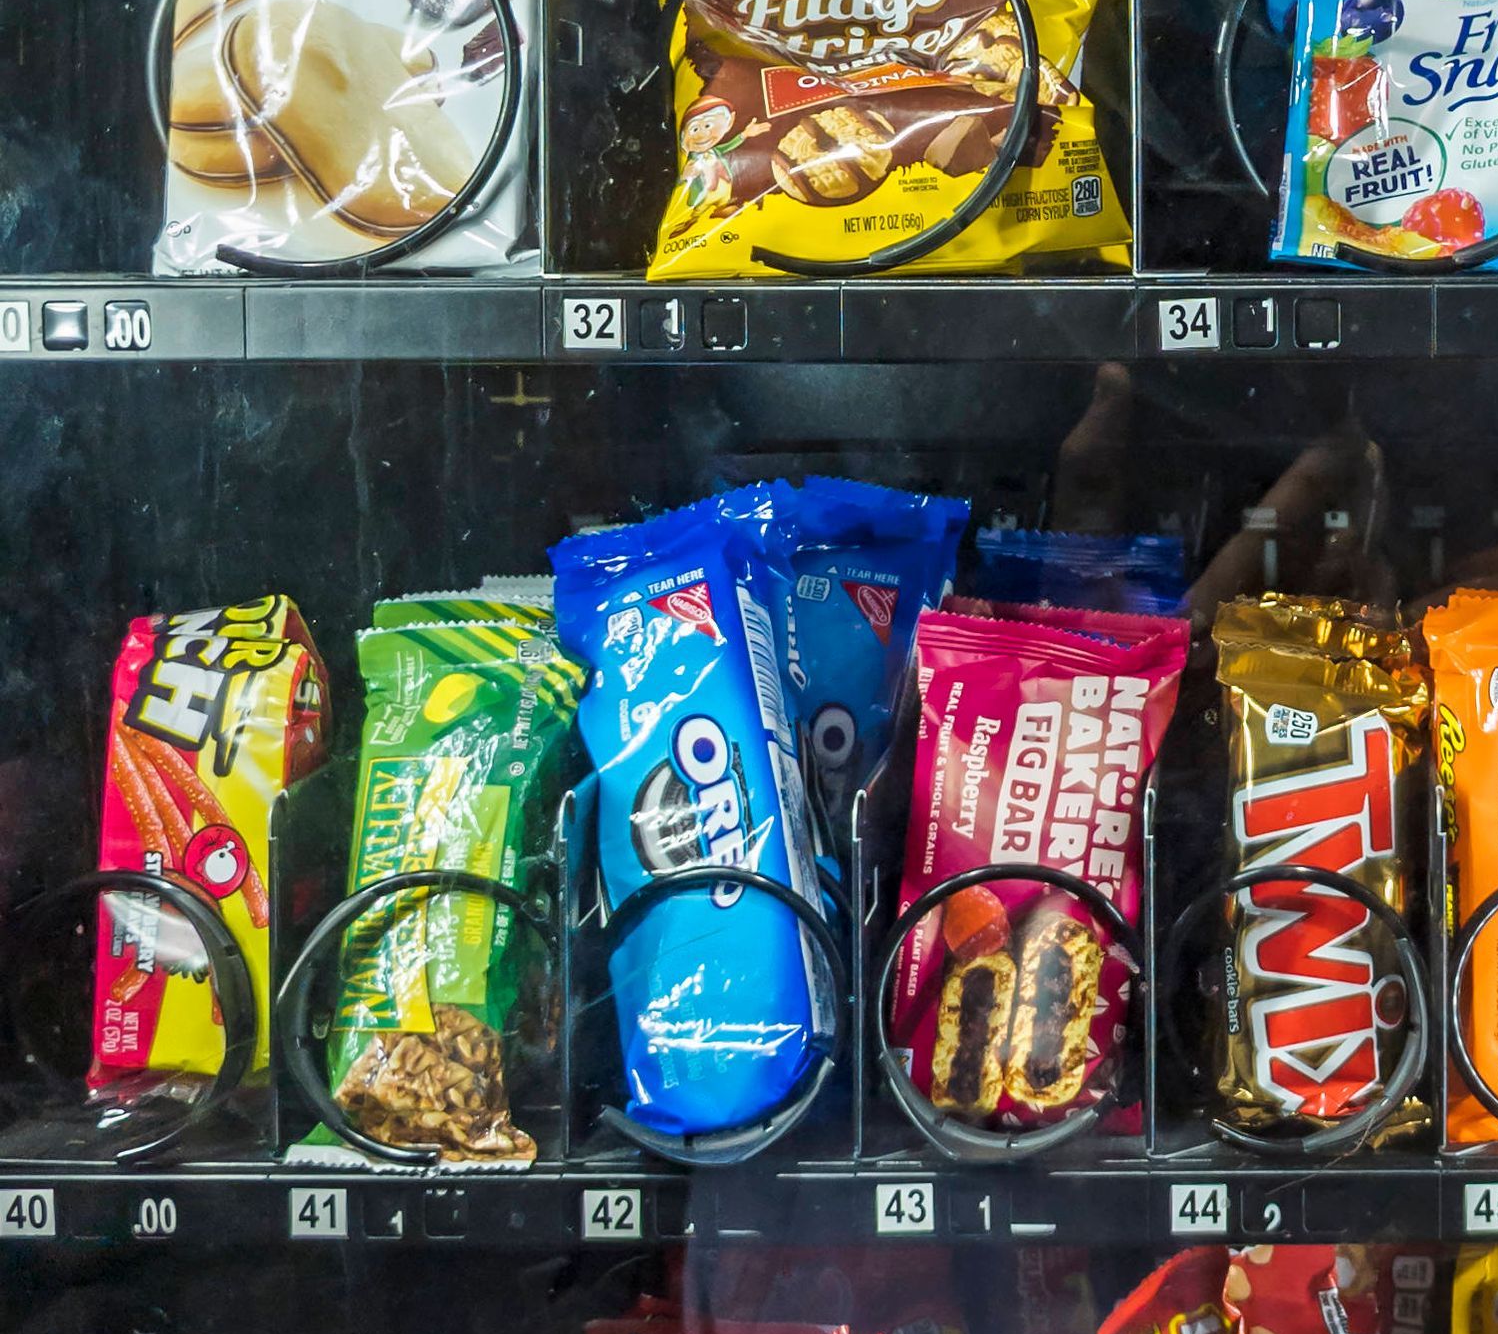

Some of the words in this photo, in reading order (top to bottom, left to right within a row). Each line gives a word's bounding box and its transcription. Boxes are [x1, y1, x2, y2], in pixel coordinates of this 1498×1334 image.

[1351, 144, 1422, 180] REAL
[1462, 143, 1484, 157] No
[1025, 188, 1070, 206] FRUCTOSE
[1075, 180, 1100, 201] 280
[1345, 166, 1434, 204] FRUIT!
[844, 218, 861, 233] NET
[1042, 205, 1070, 221] SYRUP
[663, 234, 707, 254] COOKIES
[572, 303, 616, 340] 32
[1168, 305, 1212, 340] 34
[648, 579, 675, 595] TEAR
[677, 567, 705, 589] HERE
[946, 681, 964, 713] REAL
[938, 713, 956, 756] FRUIT
[1017, 716, 1052, 764] FIG
[1288, 710, 1313, 741] 250
[931, 767, 945, 818] WHOLE
[952, 715, 1001, 840] Raspberry
[677, 717, 746, 908] OREO
[1000, 779, 1042, 853] BAR
[923, 821, 939, 875] GRAINS
[1242, 724, 1396, 1119] TWIX
[1223, 947, 1239, 994] cookie
[1225, 995, 1241, 1034] bars
[6, 1195, 48, 1228] 40
[299, 1194, 339, 1229] 41
[591, 1194, 635, 1231] 42
[885, 1188, 927, 1223] 43
[1178, 1191, 1221, 1225] 44
